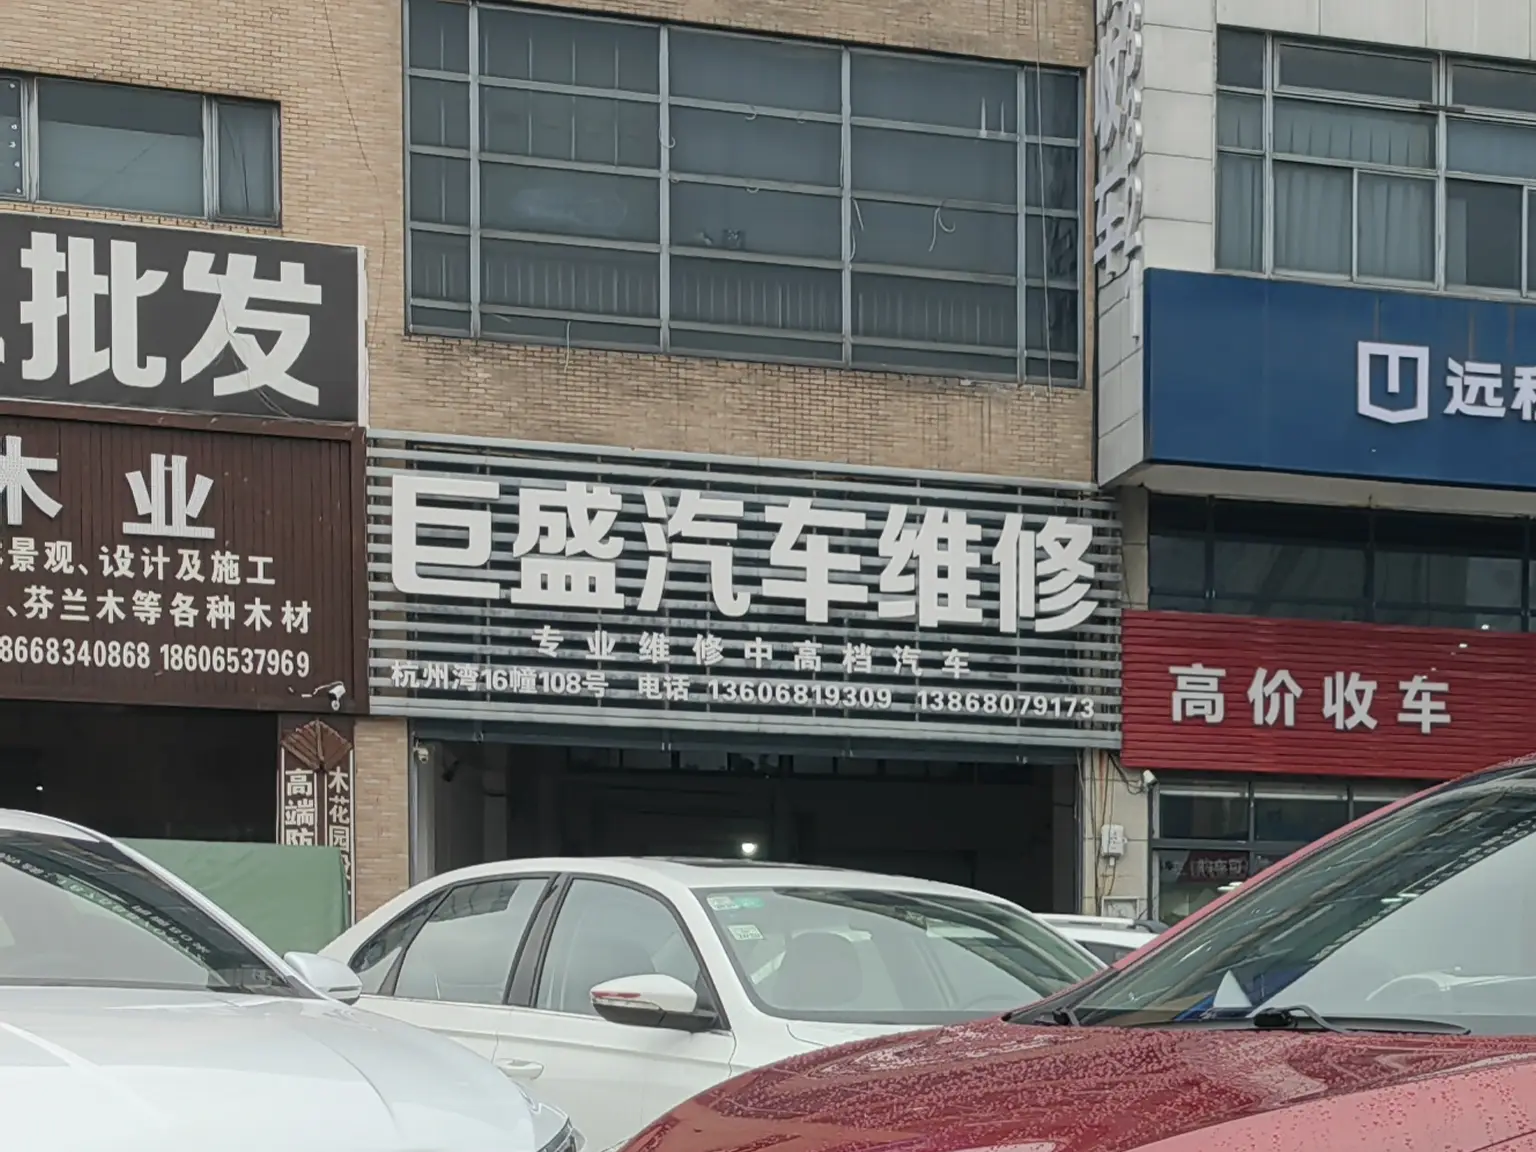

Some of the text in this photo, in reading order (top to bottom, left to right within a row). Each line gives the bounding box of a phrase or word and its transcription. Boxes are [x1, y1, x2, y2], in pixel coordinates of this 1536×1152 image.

[0, 231, 322, 406] 批发
[0, 537, 276, 585] 景观、设计及施工
[391, 473, 1100, 634] 巨盛汽车维修
[160, 643, 310, 678] 18606537969
[531, 624, 972, 679] 专业维修中高档汽车
[391, 659, 1096, 719] 杭州湾16幢108号 电话 13606819309 13868079173
[1168, 663, 1451, 734] 高价收车
